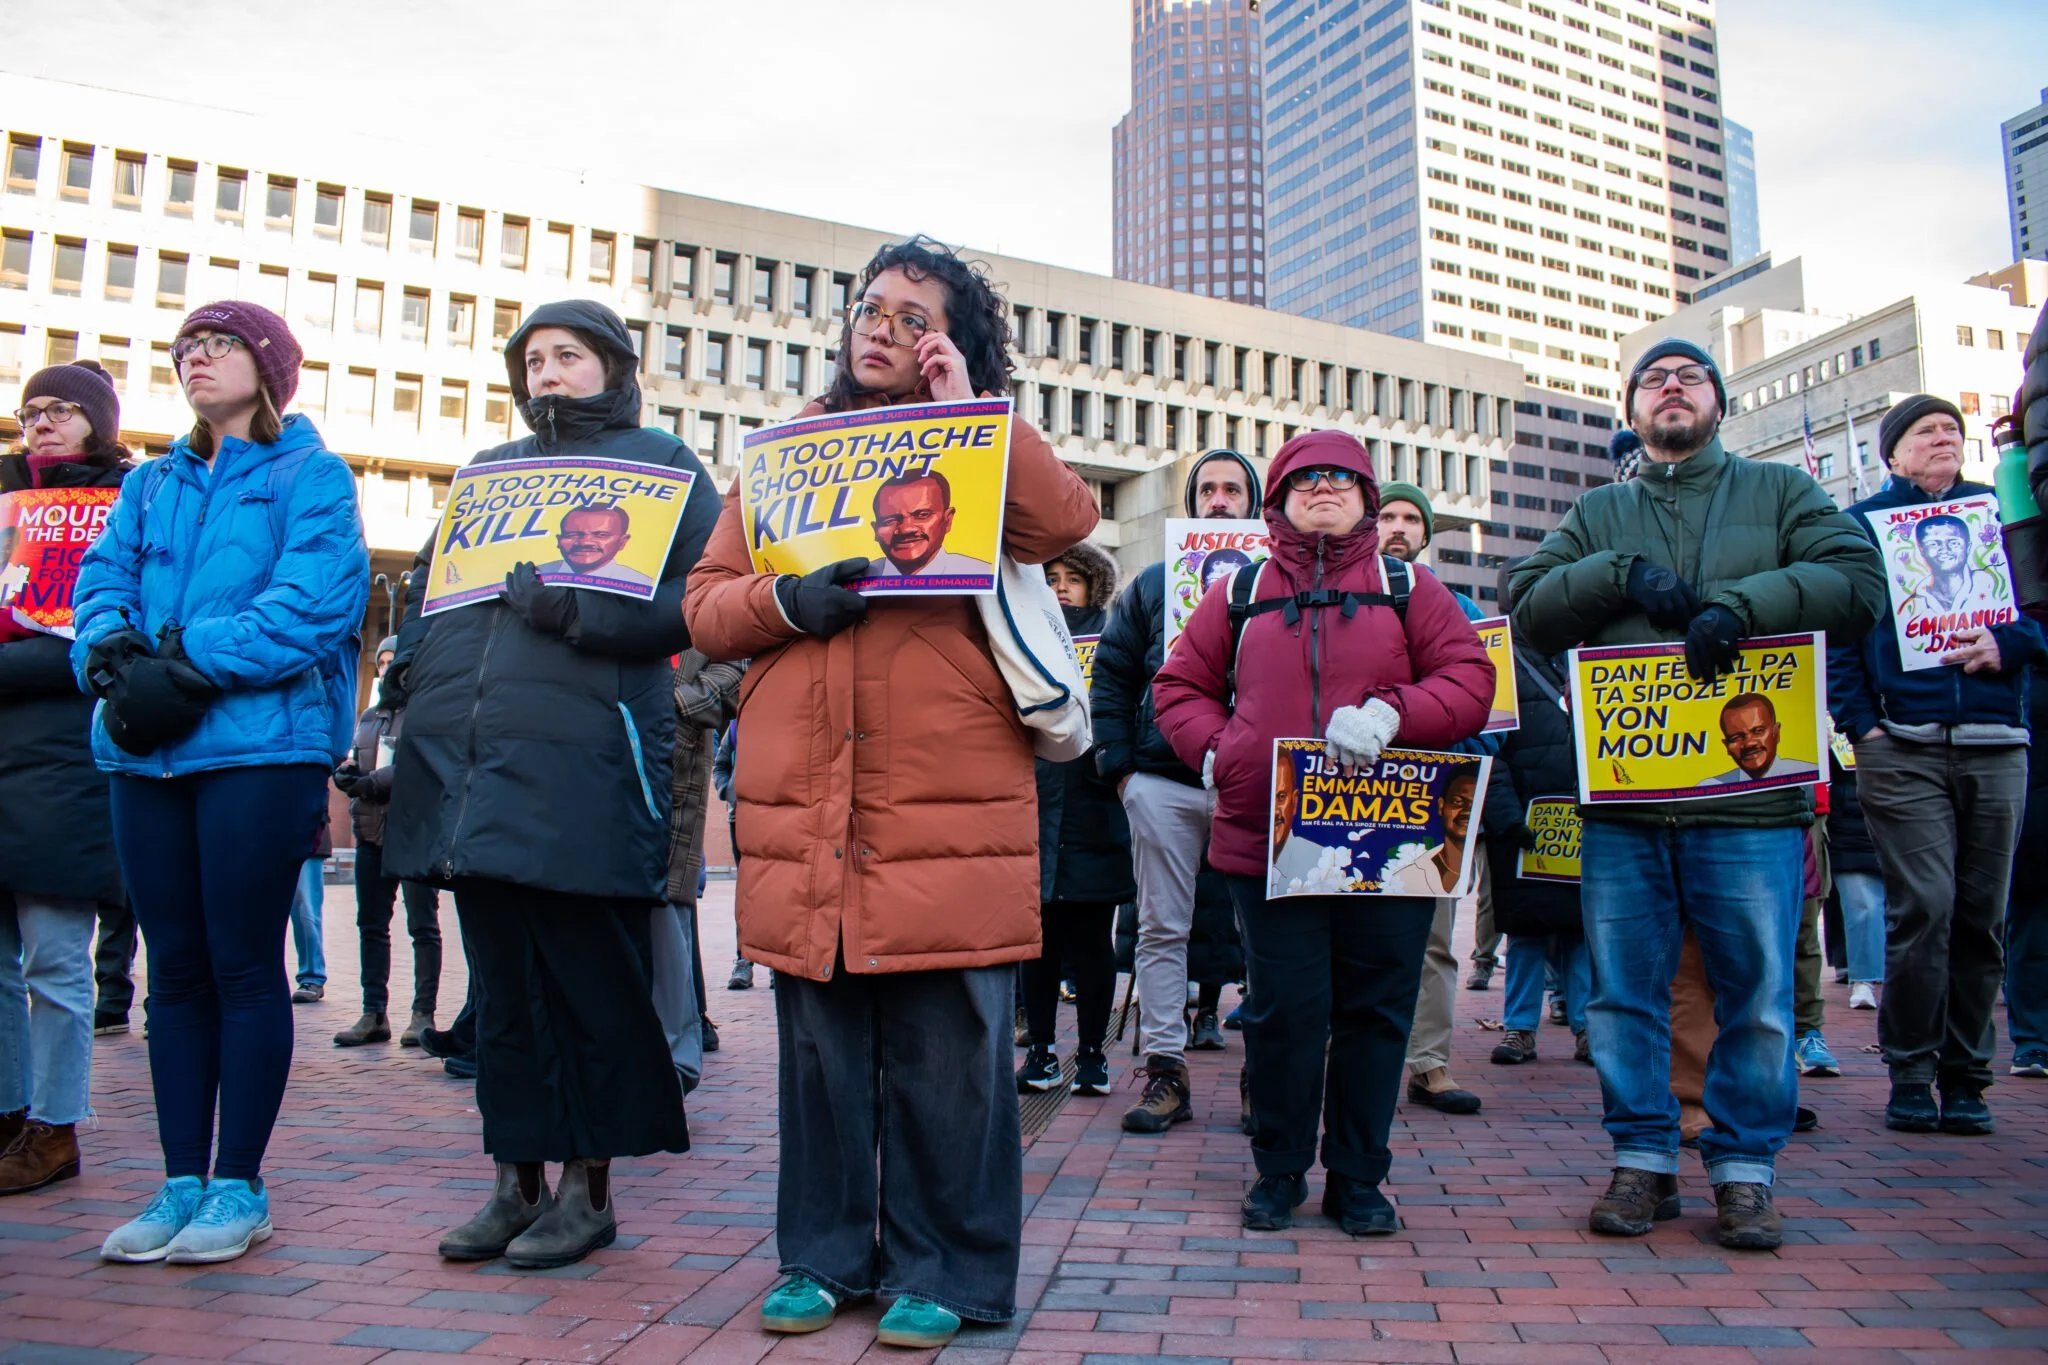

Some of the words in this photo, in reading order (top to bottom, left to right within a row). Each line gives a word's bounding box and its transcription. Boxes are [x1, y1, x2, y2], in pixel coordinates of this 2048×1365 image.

[776, 425, 794, 435] FOR
[795, 417, 847, 432] EMMANUEL
[849, 413, 884, 425] DAMAS
[885, 408, 925, 420] JUSTICE
[927, 407, 949, 416] FOR
[950, 403, 1009, 414] EMMANUEL
[749, 453, 768, 479] A
[778, 425, 998, 470] TOOTHACHE
[584, 460, 619, 469] JUSTICE
[620, 464, 639, 472] FOR
[640, 466, 690, 481] EMMANUEL
[749, 453, 942, 504] SHOULDN'T
[455, 482, 475, 501] A
[486, 473, 680, 502] TOOTHACHE
[18, 505, 111, 527] MOUR
[451, 490, 626, 521] SHOULDN'T
[1884, 503, 1963, 525] JUSTICE
[442, 508, 551, 556] KILL
[754, 486, 864, 553] KILL
[26, 528, 65, 542] THE
[69, 528, 100, 542] DE
[1177, 532, 1256, 551] JUSTICE
[38, 568, 79, 581] FOR
[573, 576, 593, 584] FOR
[595, 578, 648, 593] EMMANUEL
[860, 578, 900, 589] JUSTICE
[903, 578, 925, 587] FOR
[928, 577, 990, 587] EMMANUEL
[0, 583, 76, 607] LIVI
[1905, 607, 2015, 638] EMMANUEL
[1590, 664, 1647, 685] DAN
[1655, 656, 1686, 681] FÈ
[1760, 652, 1798, 671] PA
[1592, 687, 1624, 705] TA
[1631, 679, 1727, 703] SIPOZE
[1735, 672, 1794, 695] TIYE
[1595, 705, 1671, 732] YON
[1597, 731, 1708, 761] MOUN
[1303, 755, 1375, 777] JISIS
[1382, 762, 1438, 783] POU
[1303, 775, 1435, 800] EMMANUEL
[1301, 794, 1430, 825] DAMAS
[1533, 817, 1549, 827] TA
[1534, 806, 1564, 816] DAN
[1533, 828, 1573, 842] YON
